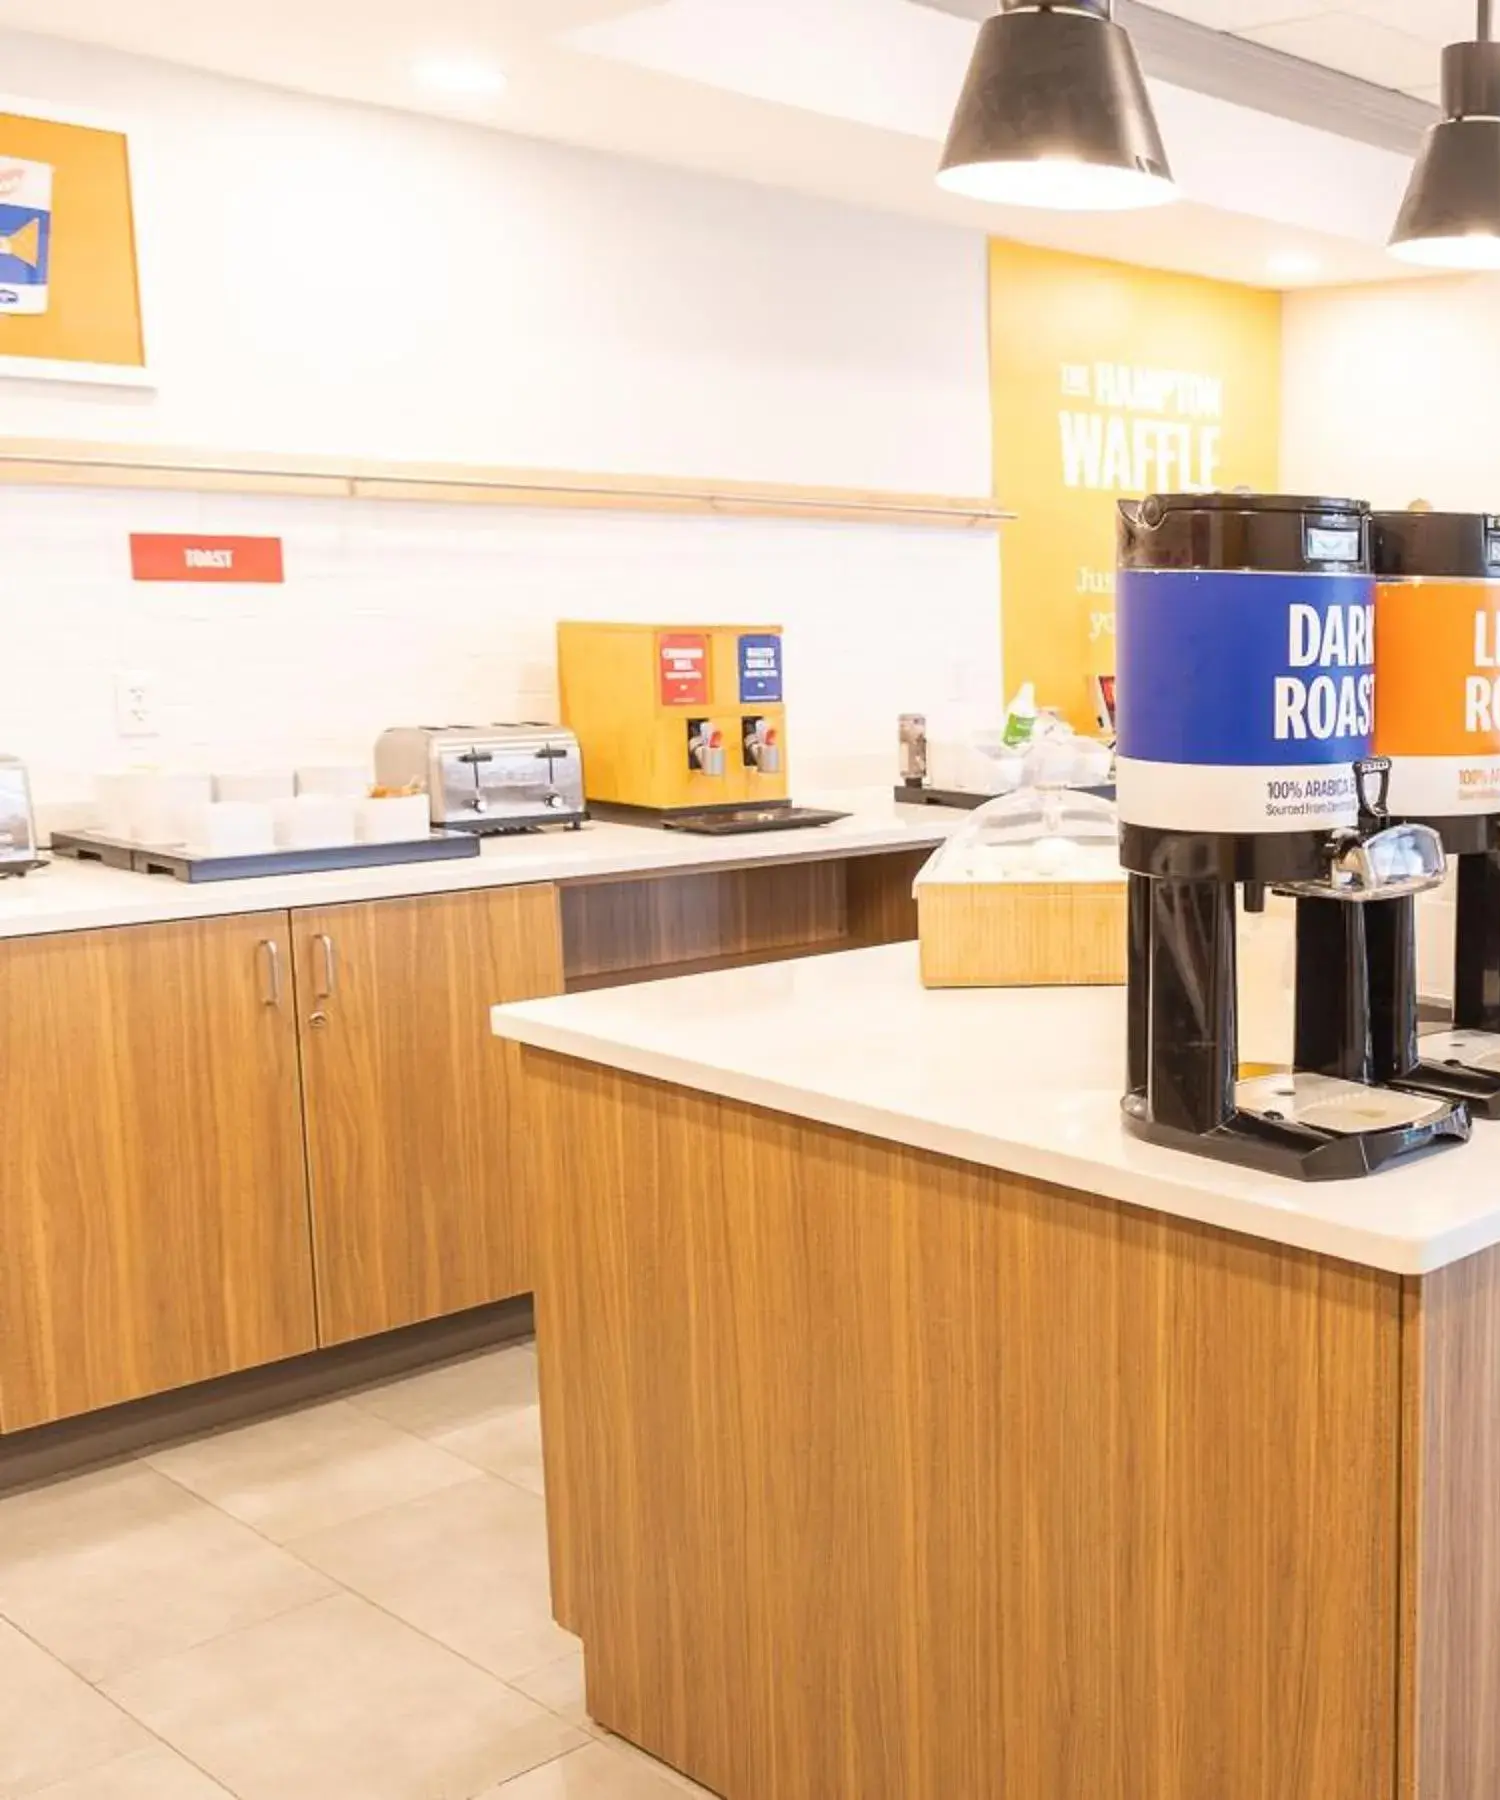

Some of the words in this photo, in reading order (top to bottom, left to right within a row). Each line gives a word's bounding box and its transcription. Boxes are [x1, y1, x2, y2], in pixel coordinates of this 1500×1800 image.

[1095, 361, 1222, 419] HAMPTON
[1058, 409, 1222, 495] WAFFLE
[185, 547, 233, 568] TOAST
[1266, 780, 1302, 800] 100%
